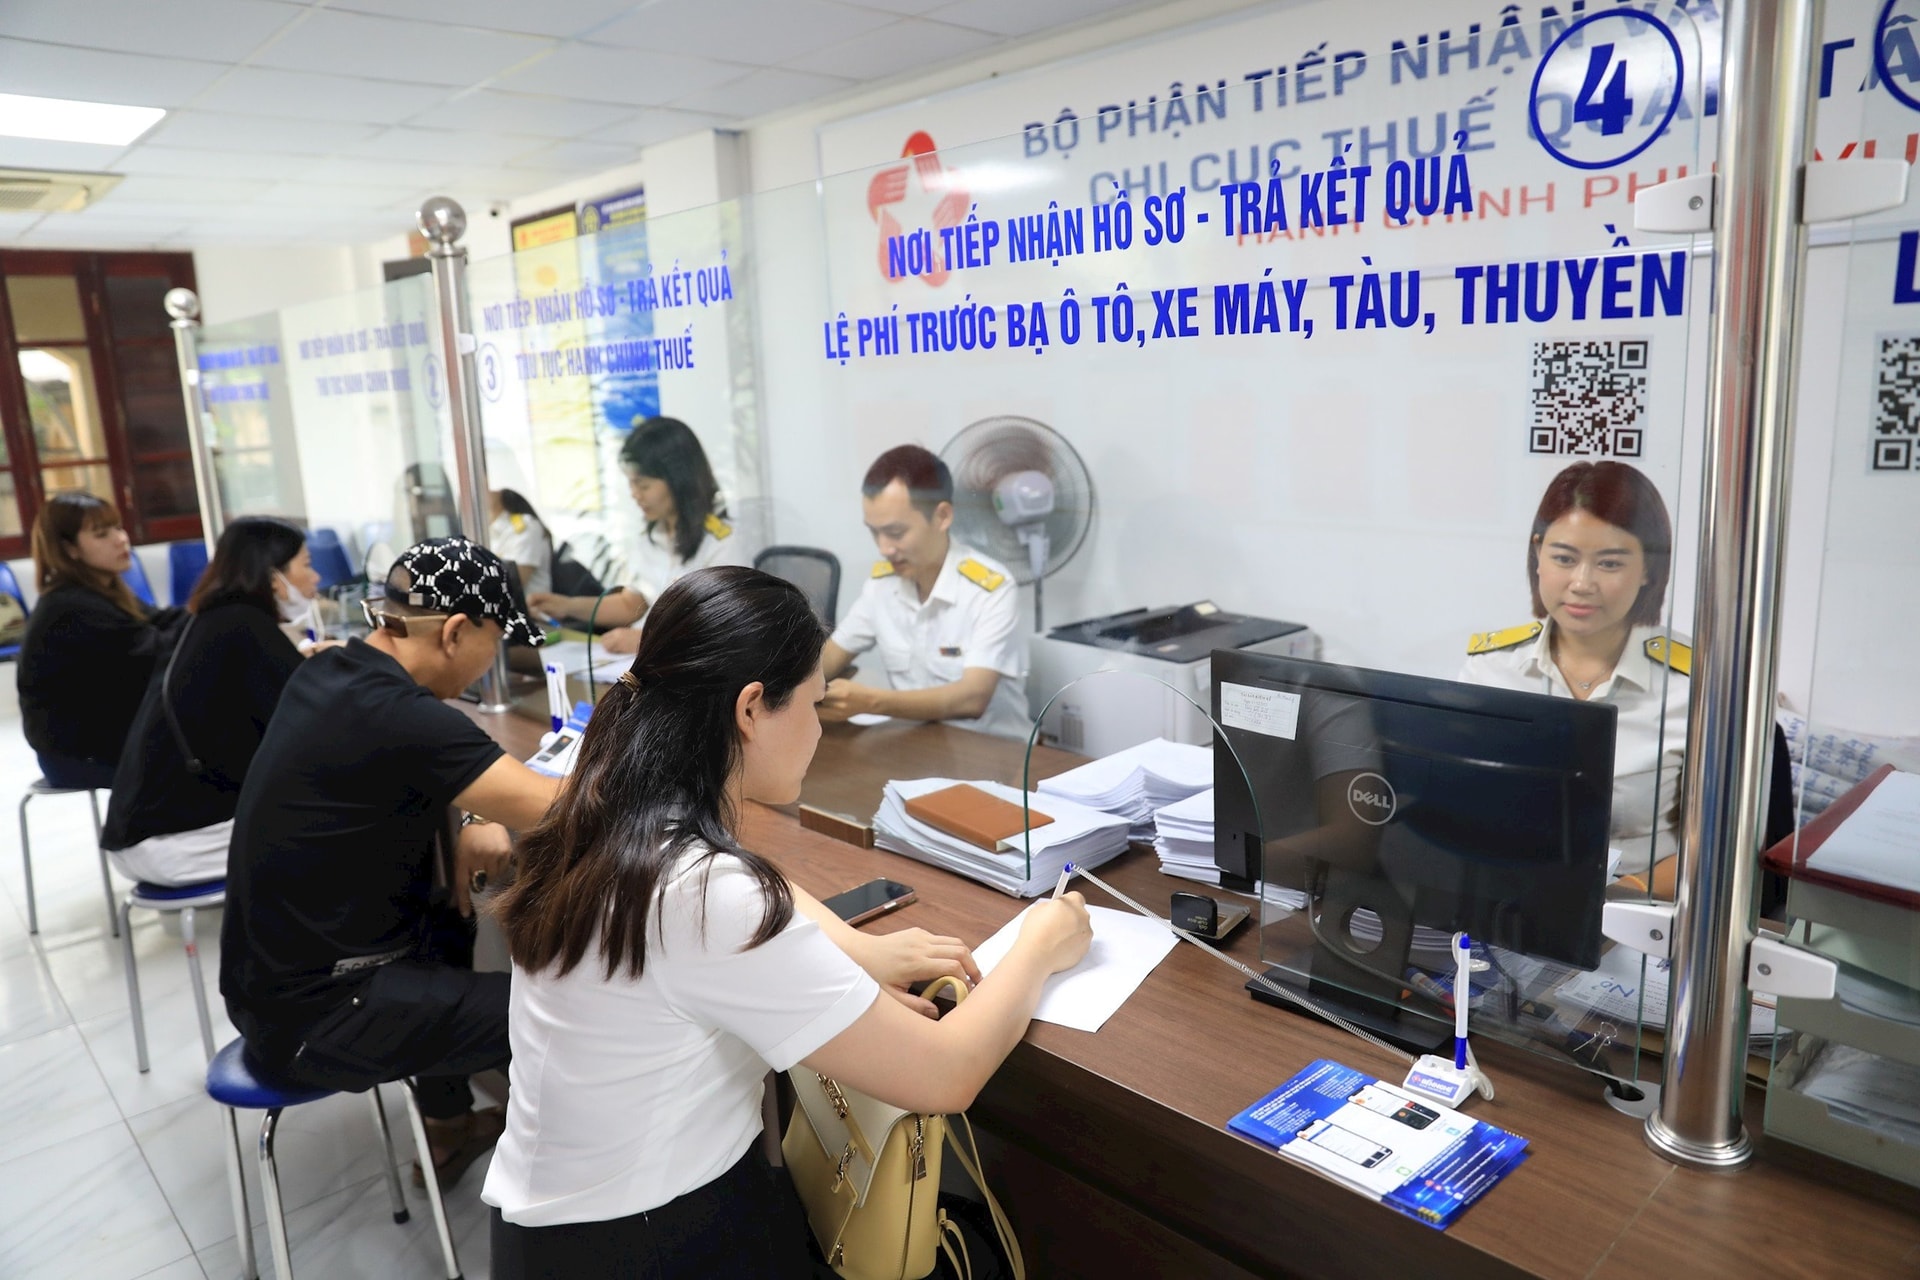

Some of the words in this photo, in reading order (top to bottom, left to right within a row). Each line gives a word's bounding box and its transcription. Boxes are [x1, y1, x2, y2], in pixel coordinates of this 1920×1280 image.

[1023, 106, 1079, 160] BỘ
[1097, 80, 1227, 144] PHẬN
[1244, 40, 1368, 112] TIẾP
[1391, 0, 1585, 85] NHẬN
[1573, 43, 1633, 136] 4
[1321, 86, 1497, 170] THUẾ
[887, 227, 932, 278] NƠI
[939, 203, 1000, 271] TIẾP
[1007, 200, 1085, 267] NHẬN
[1092, 180, 1132, 253] HỒ
[1143, 185, 1186, 246] SƠ
[1197, 212, 1209, 223] -
[1219, 158, 1288, 237] TRẢ
[1299, 142, 1372, 229] KẾT
[1384, 129, 1473, 226] QUẢ
[627, 263, 660, 314] TRẢ
[661, 258, 693, 309] KẾT
[696, 249, 734, 309] QUẢ
[824, 311, 851, 366] LỆ
[857, 304, 899, 357] PHÍ
[906, 294, 997, 354] TRƯỚC
[1006, 301, 1050, 355] BẠ
[1059, 287, 1081, 345] Ô
[1091, 282, 1146, 348] TÔ,
[1151, 286, 1200, 339] XE
[1214, 267, 1314, 340] MÁY,
[1329, 256, 1436, 335] TÀU,
[1454, 223, 1687, 326] THUYỀN
[484, 354, 497, 391] 3
[653, 323, 695, 372] THUẾ
[1352, 789, 1391, 809] DELL
